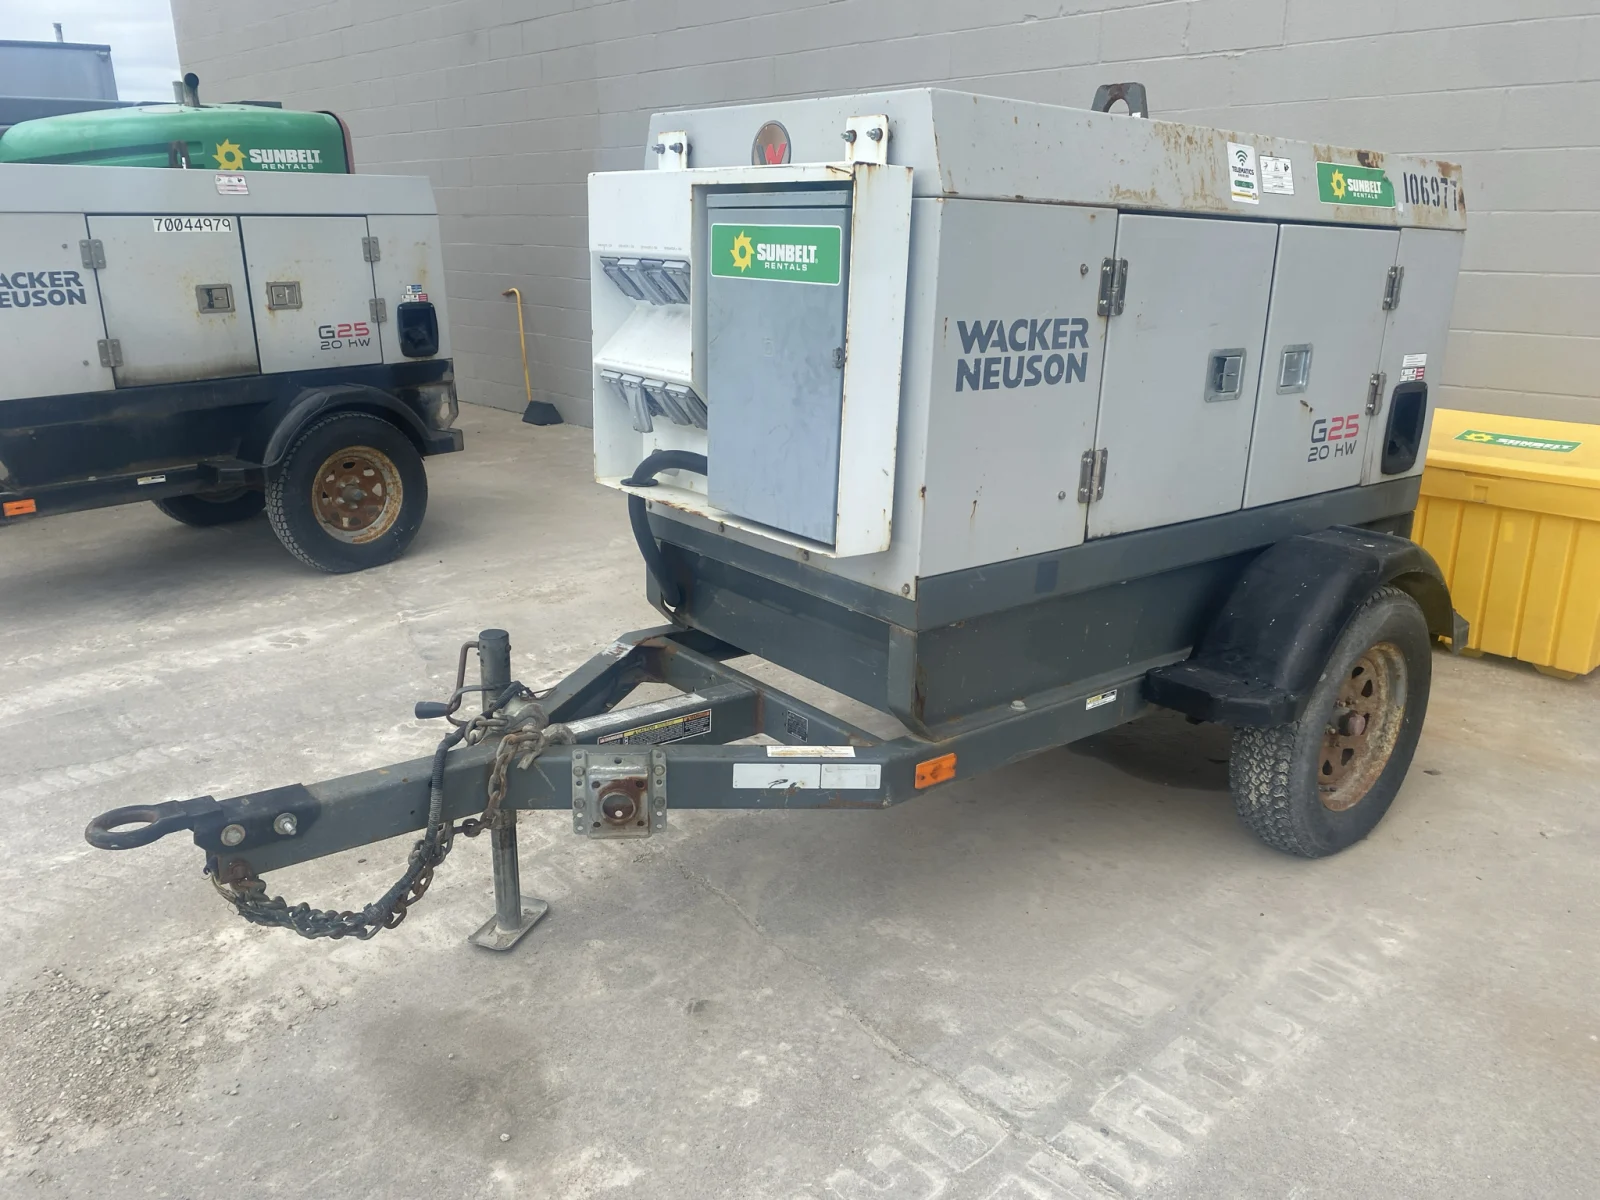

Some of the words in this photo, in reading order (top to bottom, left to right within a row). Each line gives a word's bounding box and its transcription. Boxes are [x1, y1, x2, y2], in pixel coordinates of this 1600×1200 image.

[248, 149, 321, 164] SUNBELT
[1346, 178, 1382, 194] SUNBELT
[1403, 171, 1458, 211] 106977
[1352, 191, 1378, 199] RENTALS
[153, 218, 231, 231] 70044979
[756, 243, 818, 264] SUNBELT
[764, 262, 808, 272] RENTALS
[318, 322, 370, 340] G25
[956, 317, 1090, 355] WACKER
[320, 340, 343, 351] 20
[955, 352, 1089, 393] NEUSON
[1311, 413, 1360, 444] G25
[1495, 437, 1573, 450] SUNBELT
[1307, 444, 1330, 463] 20
